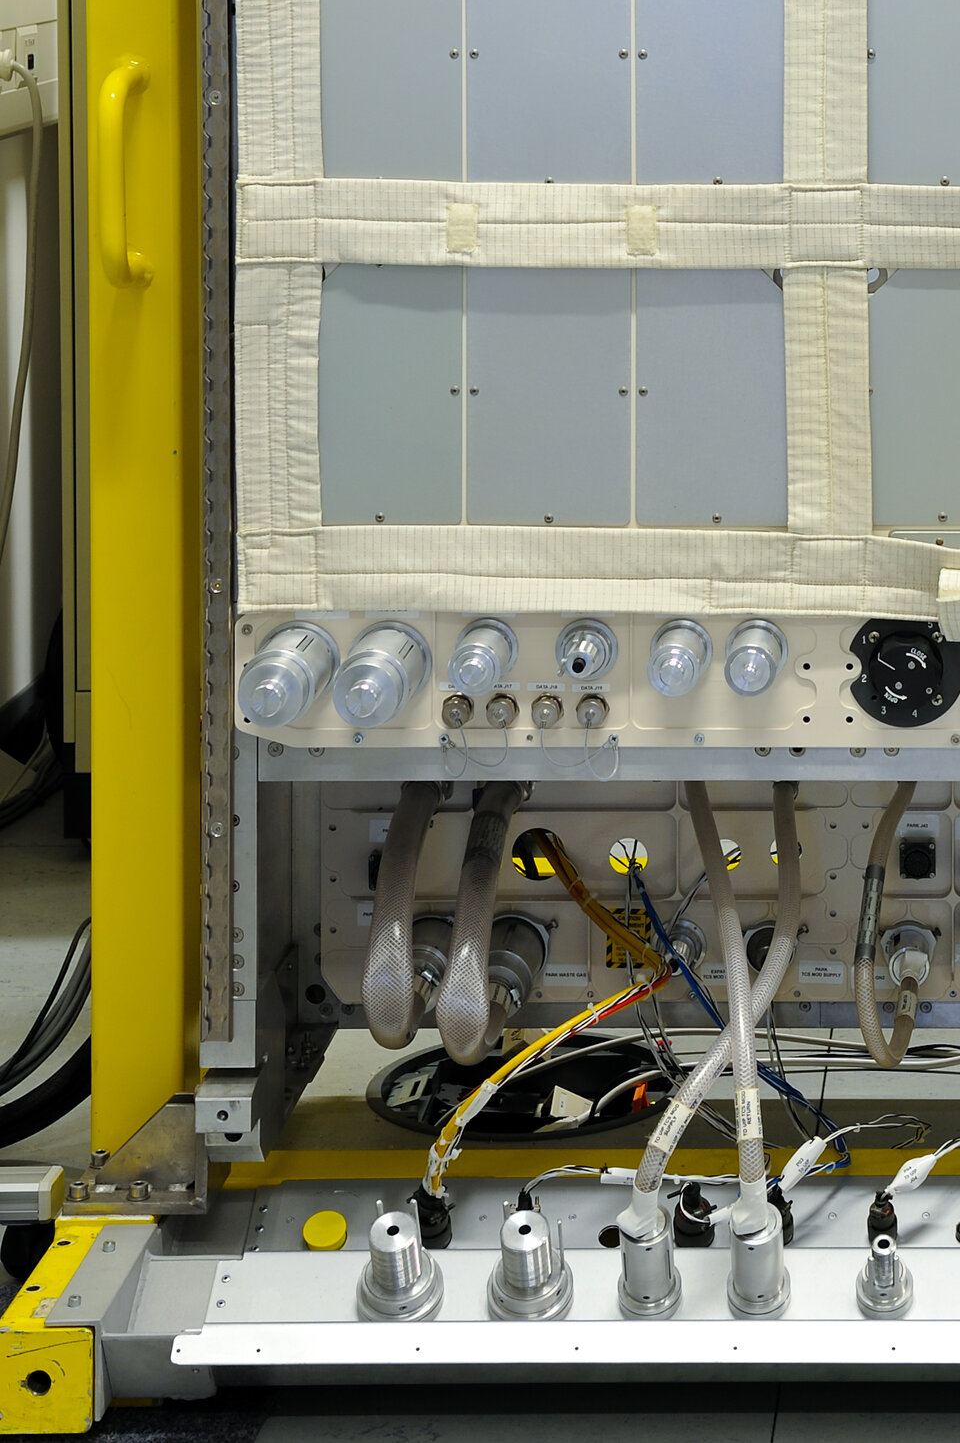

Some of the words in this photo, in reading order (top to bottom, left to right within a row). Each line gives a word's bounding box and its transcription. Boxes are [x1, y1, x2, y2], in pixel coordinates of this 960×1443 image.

[862, 635, 866, 645] 1
[910, 647, 928, 661] CLOSE
[861, 673, 867, 683] 2
[883, 692, 899, 704] OPEN
[881, 706, 887, 715] 3
[912, 709, 918, 718] 4
[663, 1116, 677, 1136] SUPPLY
